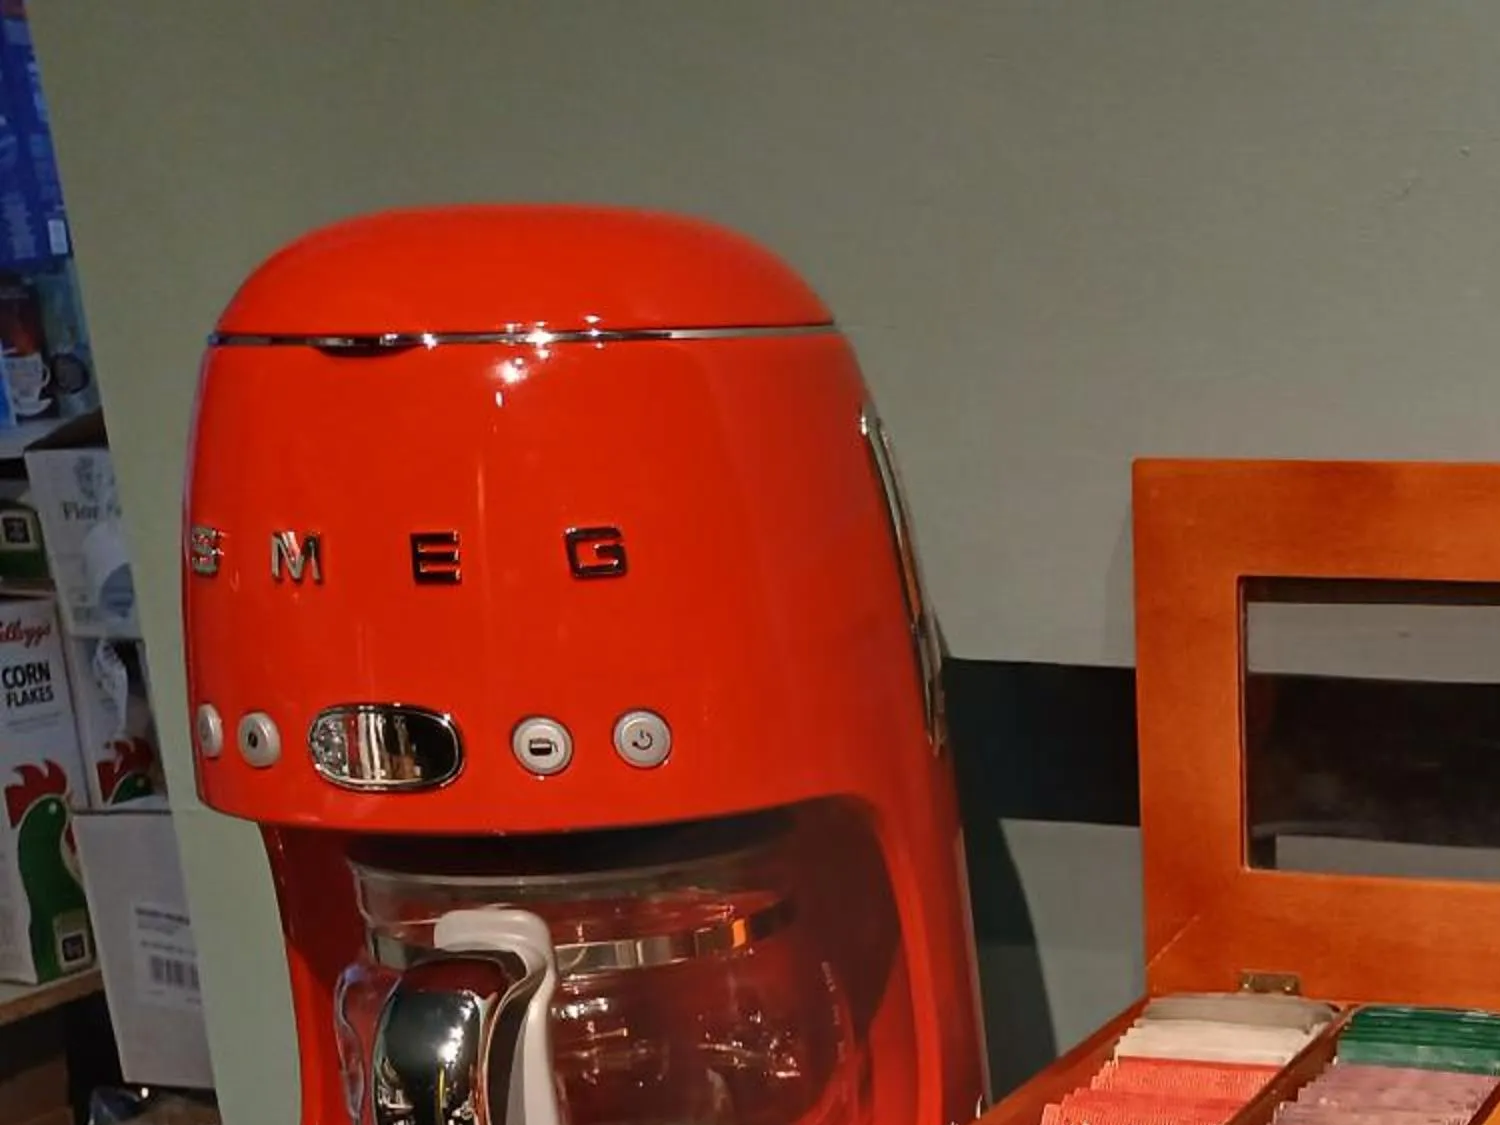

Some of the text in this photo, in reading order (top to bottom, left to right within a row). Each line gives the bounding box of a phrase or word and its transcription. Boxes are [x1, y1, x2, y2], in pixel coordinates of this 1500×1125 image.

[191, 526, 629, 584] SMEG
[2, 661, 51, 689] CORN
[6, 685, 54, 708] FLAKES
